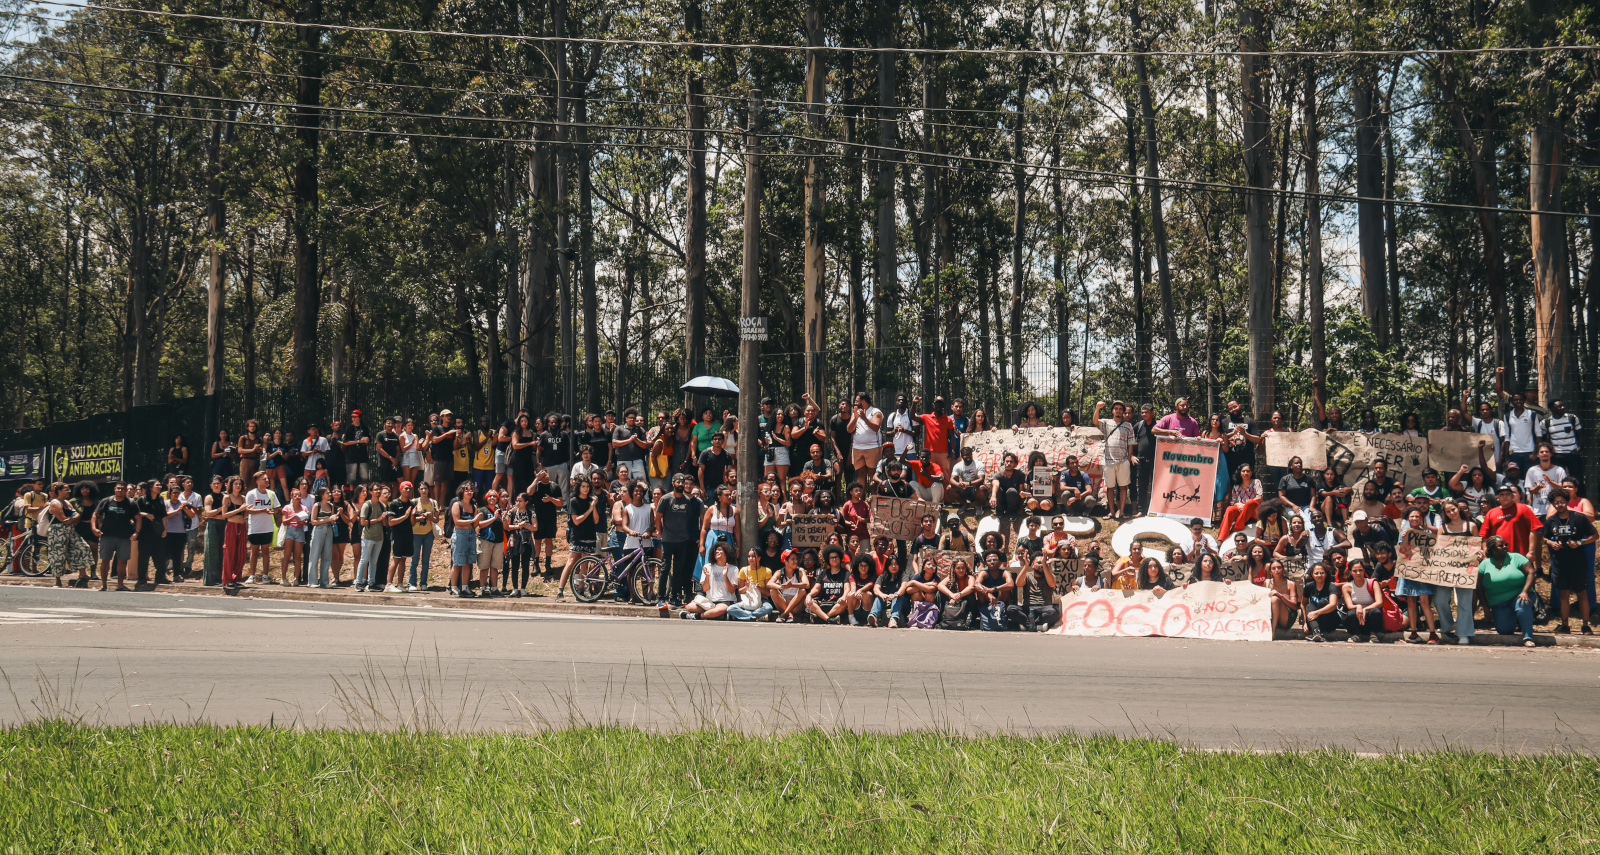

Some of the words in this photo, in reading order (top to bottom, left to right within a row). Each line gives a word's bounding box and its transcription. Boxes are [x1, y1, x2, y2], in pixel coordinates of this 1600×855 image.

[740, 317, 761, 327] ROÇA
[70, 445, 86, 459] SOU
[86, 441, 122, 458] DOCENTE
[1366, 437, 1423, 454] NECESSÁRIO
[1162, 451, 1214, 464] Novembro
[1376, 452, 1403, 468] SER
[69, 459, 121, 476] ANTIRRACISTA
[1169, 464, 1200, 477] Negro
[1355, 467, 1407, 485] ATI
[876, 497, 926, 520] FOGO
[1060, 599, 1192, 637] FOGO
[1203, 599, 1239, 614] NOS
